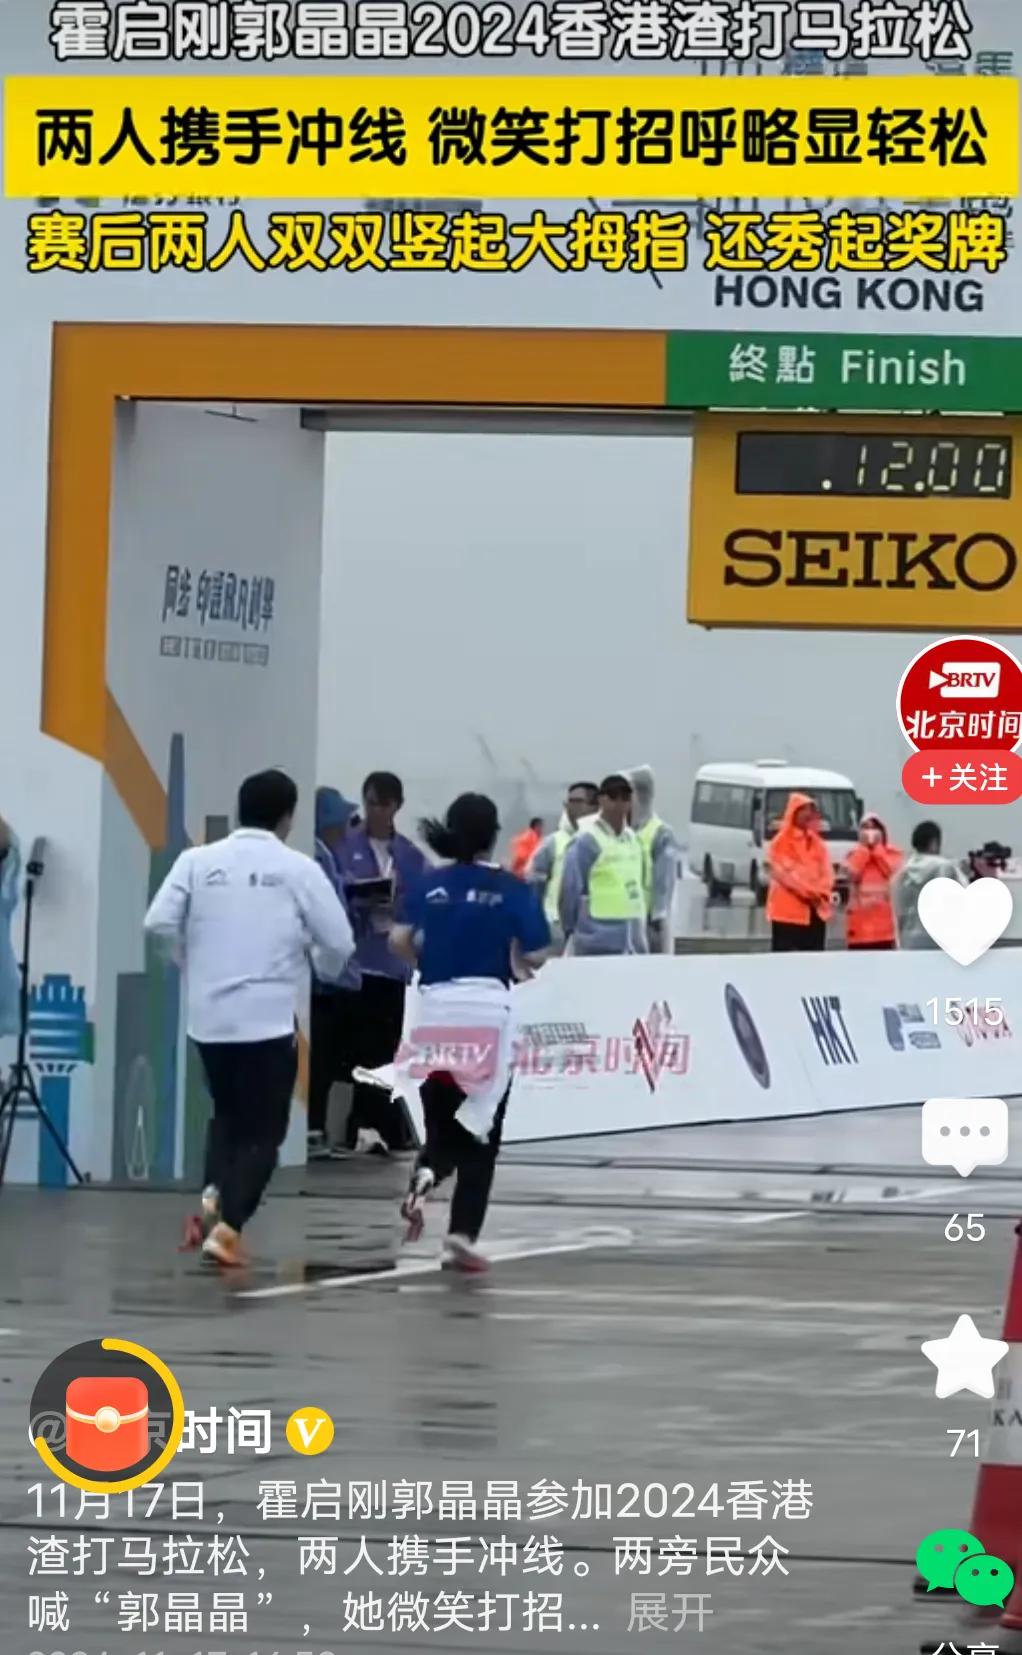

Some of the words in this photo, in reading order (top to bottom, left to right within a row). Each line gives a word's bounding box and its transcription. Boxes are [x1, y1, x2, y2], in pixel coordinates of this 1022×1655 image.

[713, 276, 842, 310] HONG
[857, 277, 985, 313] KONG
[729, 343, 816, 384] 終點
[840, 349, 967, 386] Finish
[724, 528, 1018, 592] SEIKO
